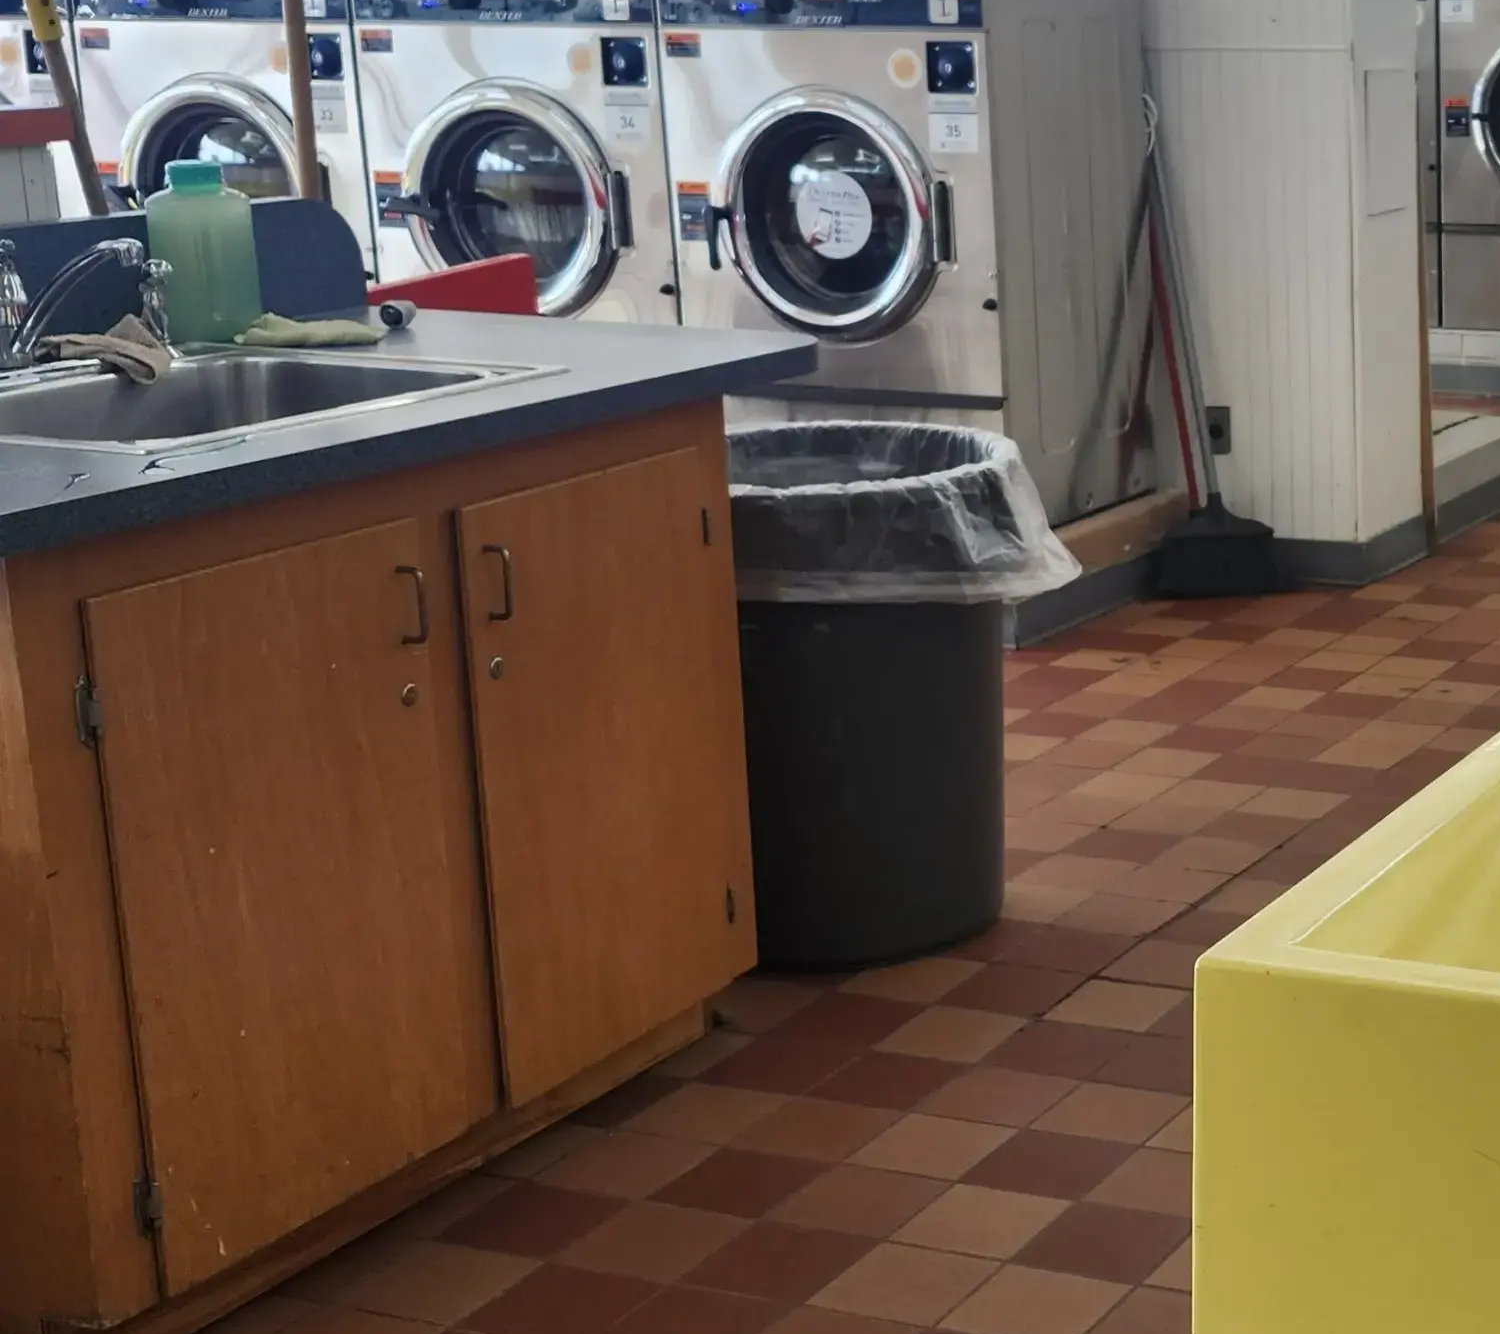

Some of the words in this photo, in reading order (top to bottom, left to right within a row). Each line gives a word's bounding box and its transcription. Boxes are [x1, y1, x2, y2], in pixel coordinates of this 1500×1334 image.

[795, 15, 842, 25] DEXTER
[620, 114, 635, 129] 34
[945, 123, 962, 138] 35
